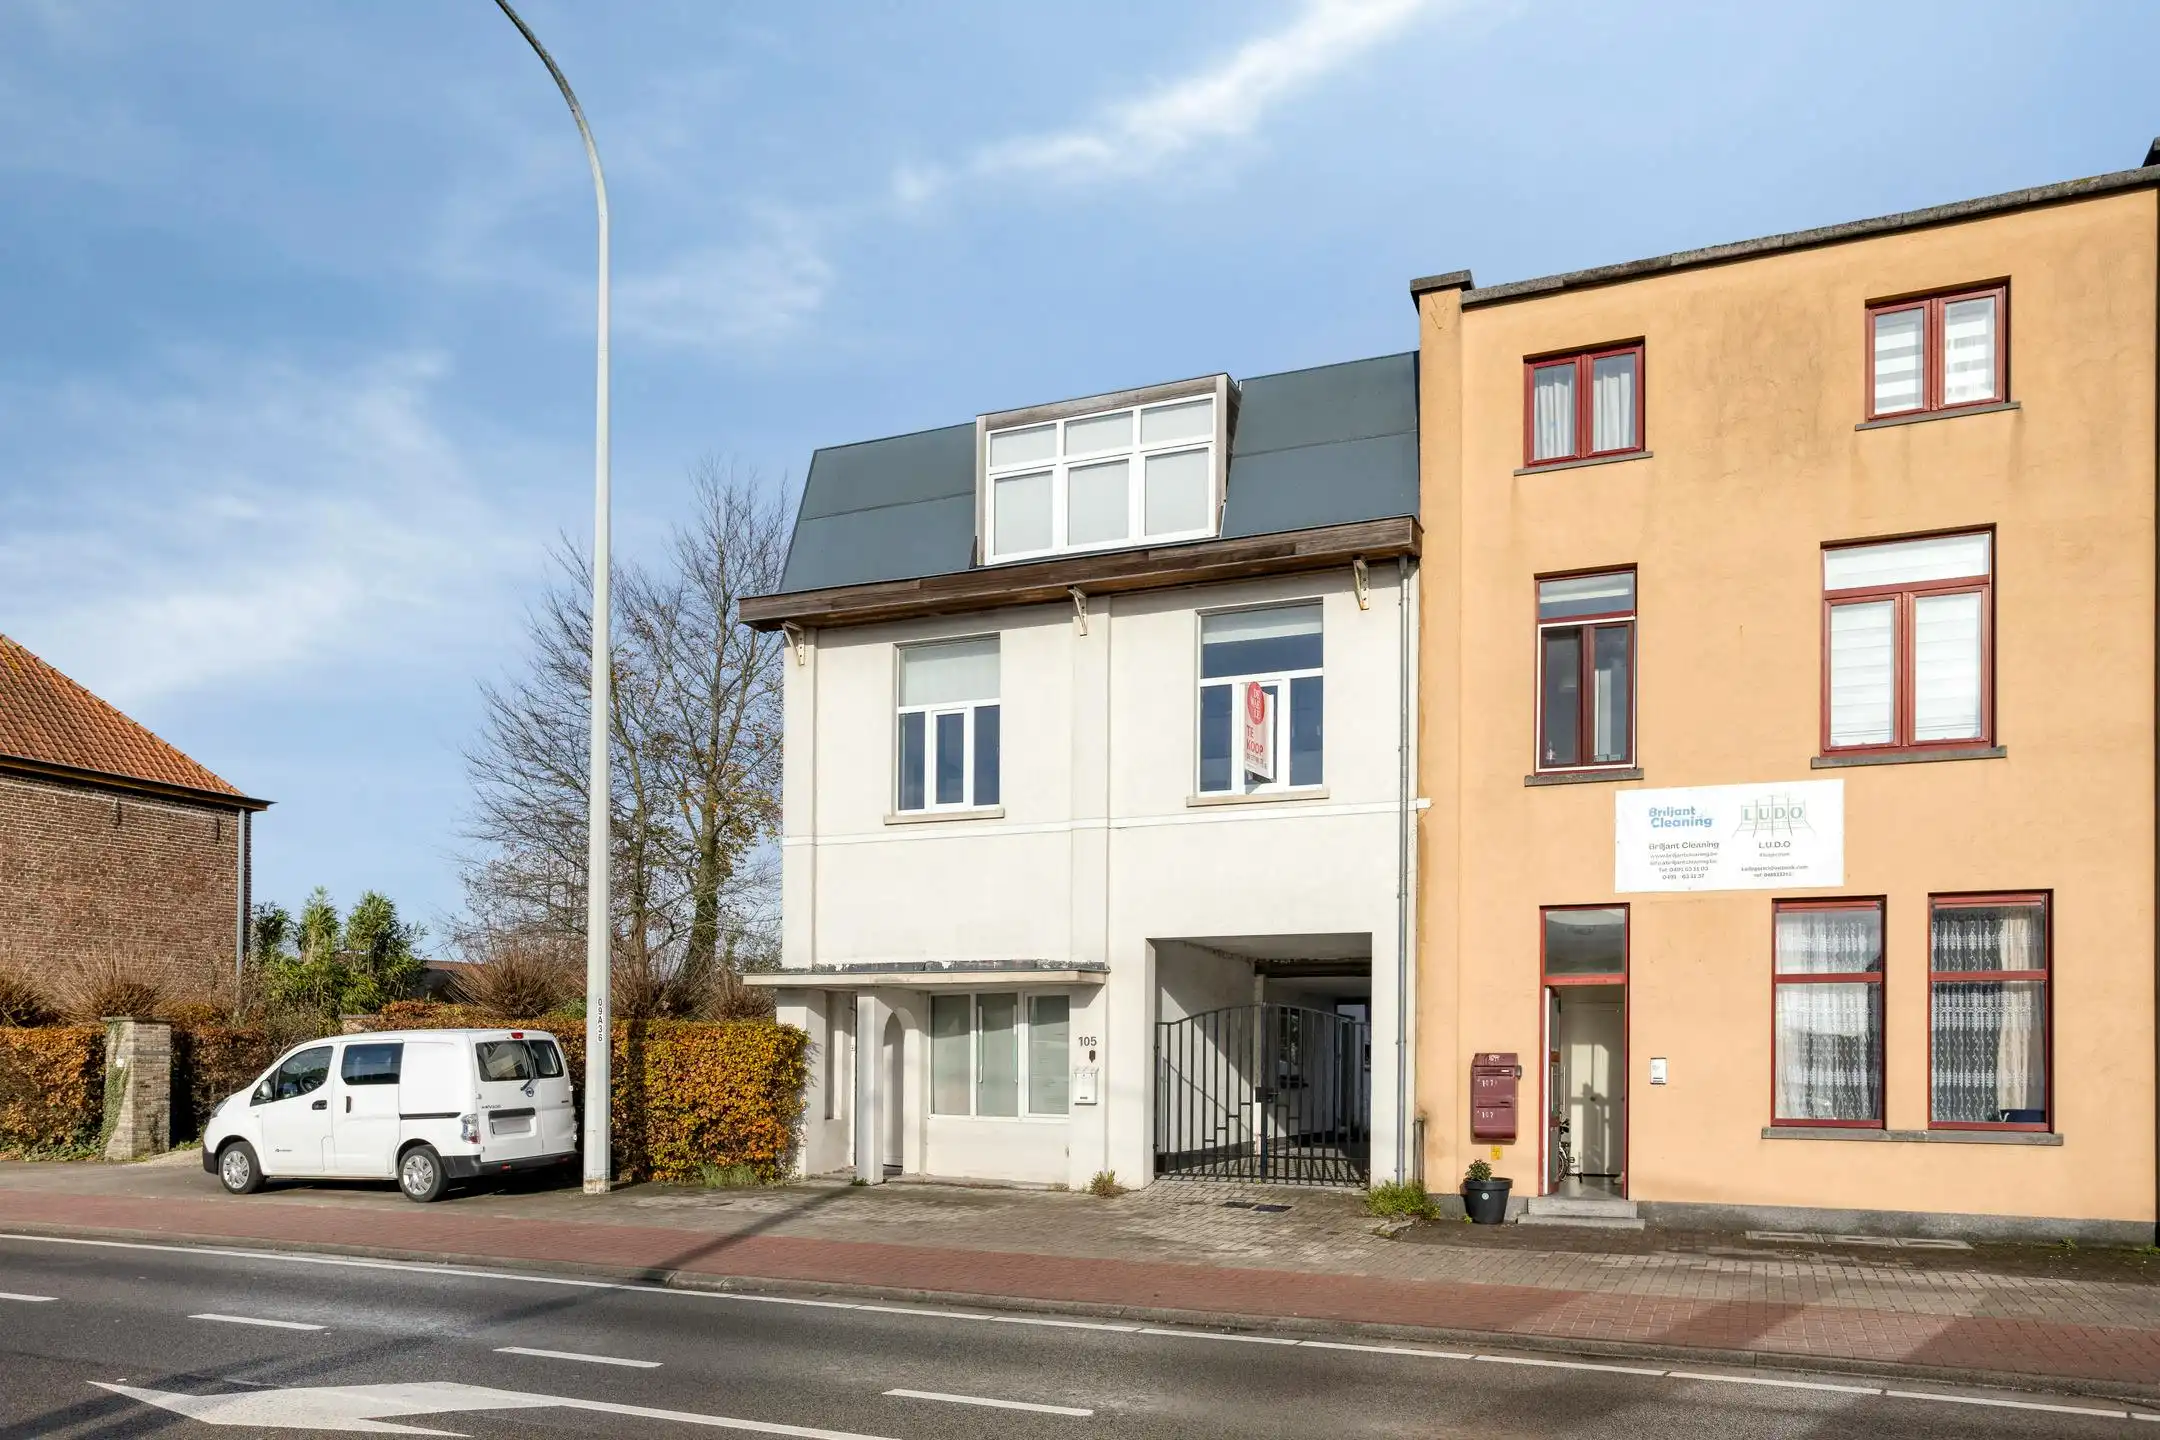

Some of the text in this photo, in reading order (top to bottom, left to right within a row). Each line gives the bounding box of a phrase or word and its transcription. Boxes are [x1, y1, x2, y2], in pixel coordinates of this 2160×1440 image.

[1246, 723, 1254, 738] TE
[1246, 739, 1264, 756] KOOP
[1648, 805, 1696, 817] Briljant
[1650, 816, 1713, 829] Cleaning
[1681, 840, 1720, 850] Cleaning
[1078, 1036, 1097, 1047] 105
